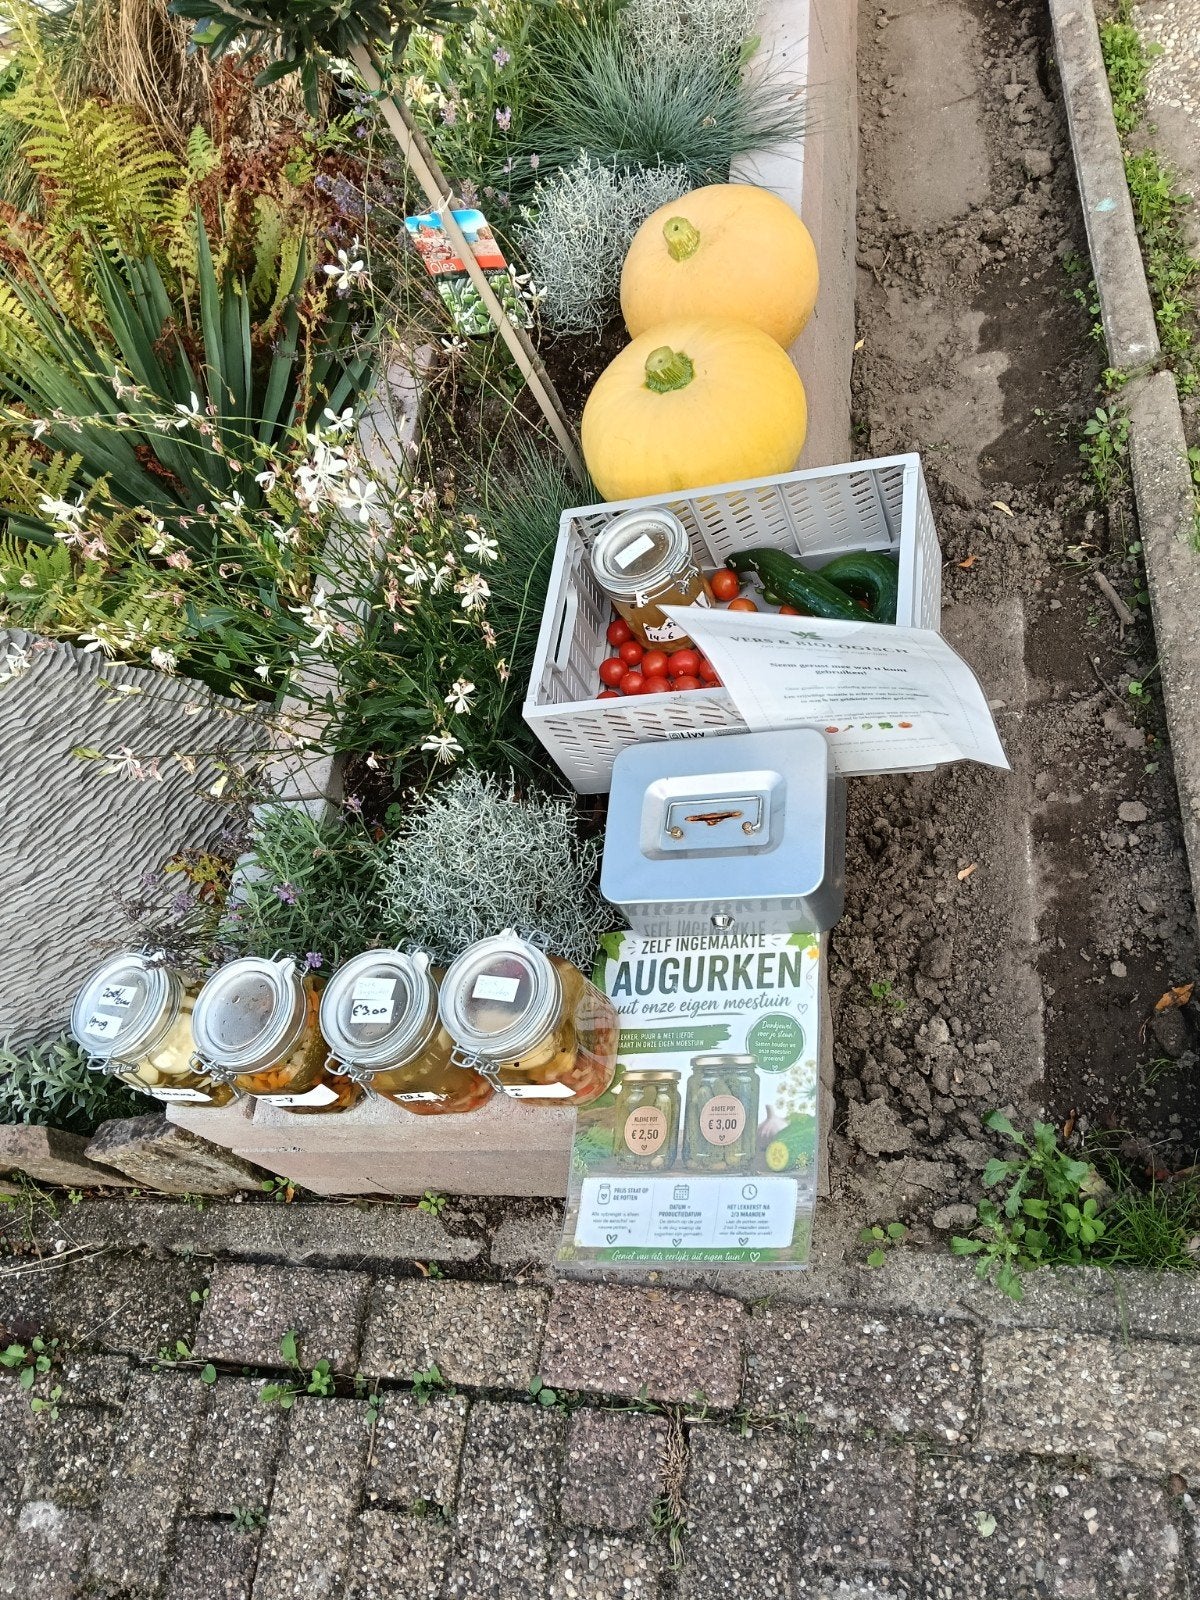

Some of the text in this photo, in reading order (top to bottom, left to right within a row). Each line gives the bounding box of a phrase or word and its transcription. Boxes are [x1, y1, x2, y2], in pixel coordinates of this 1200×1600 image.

[430, 262, 456, 274] Olea
[796, 641, 909, 654] BIOLOGISCH
[641, 934, 766, 954] ZELF INGEMAAKTE
[611, 951, 802, 997] AUGURKEN
[617, 992, 791, 1018] uit onze eigen moestuin
[708, 1119, 737, 1130] € 3,00
[632, 1129, 659, 1140] € 2,50
[612, 1250, 635, 1261] Geniet
[651, 1252, 663, 1261] iets
[665, 1252, 690, 1262] eerlijks
[691, 1252, 702, 1260] uit
[704, 1253, 723, 1262] eigen
[724, 1251, 745, 1261] tuin!
